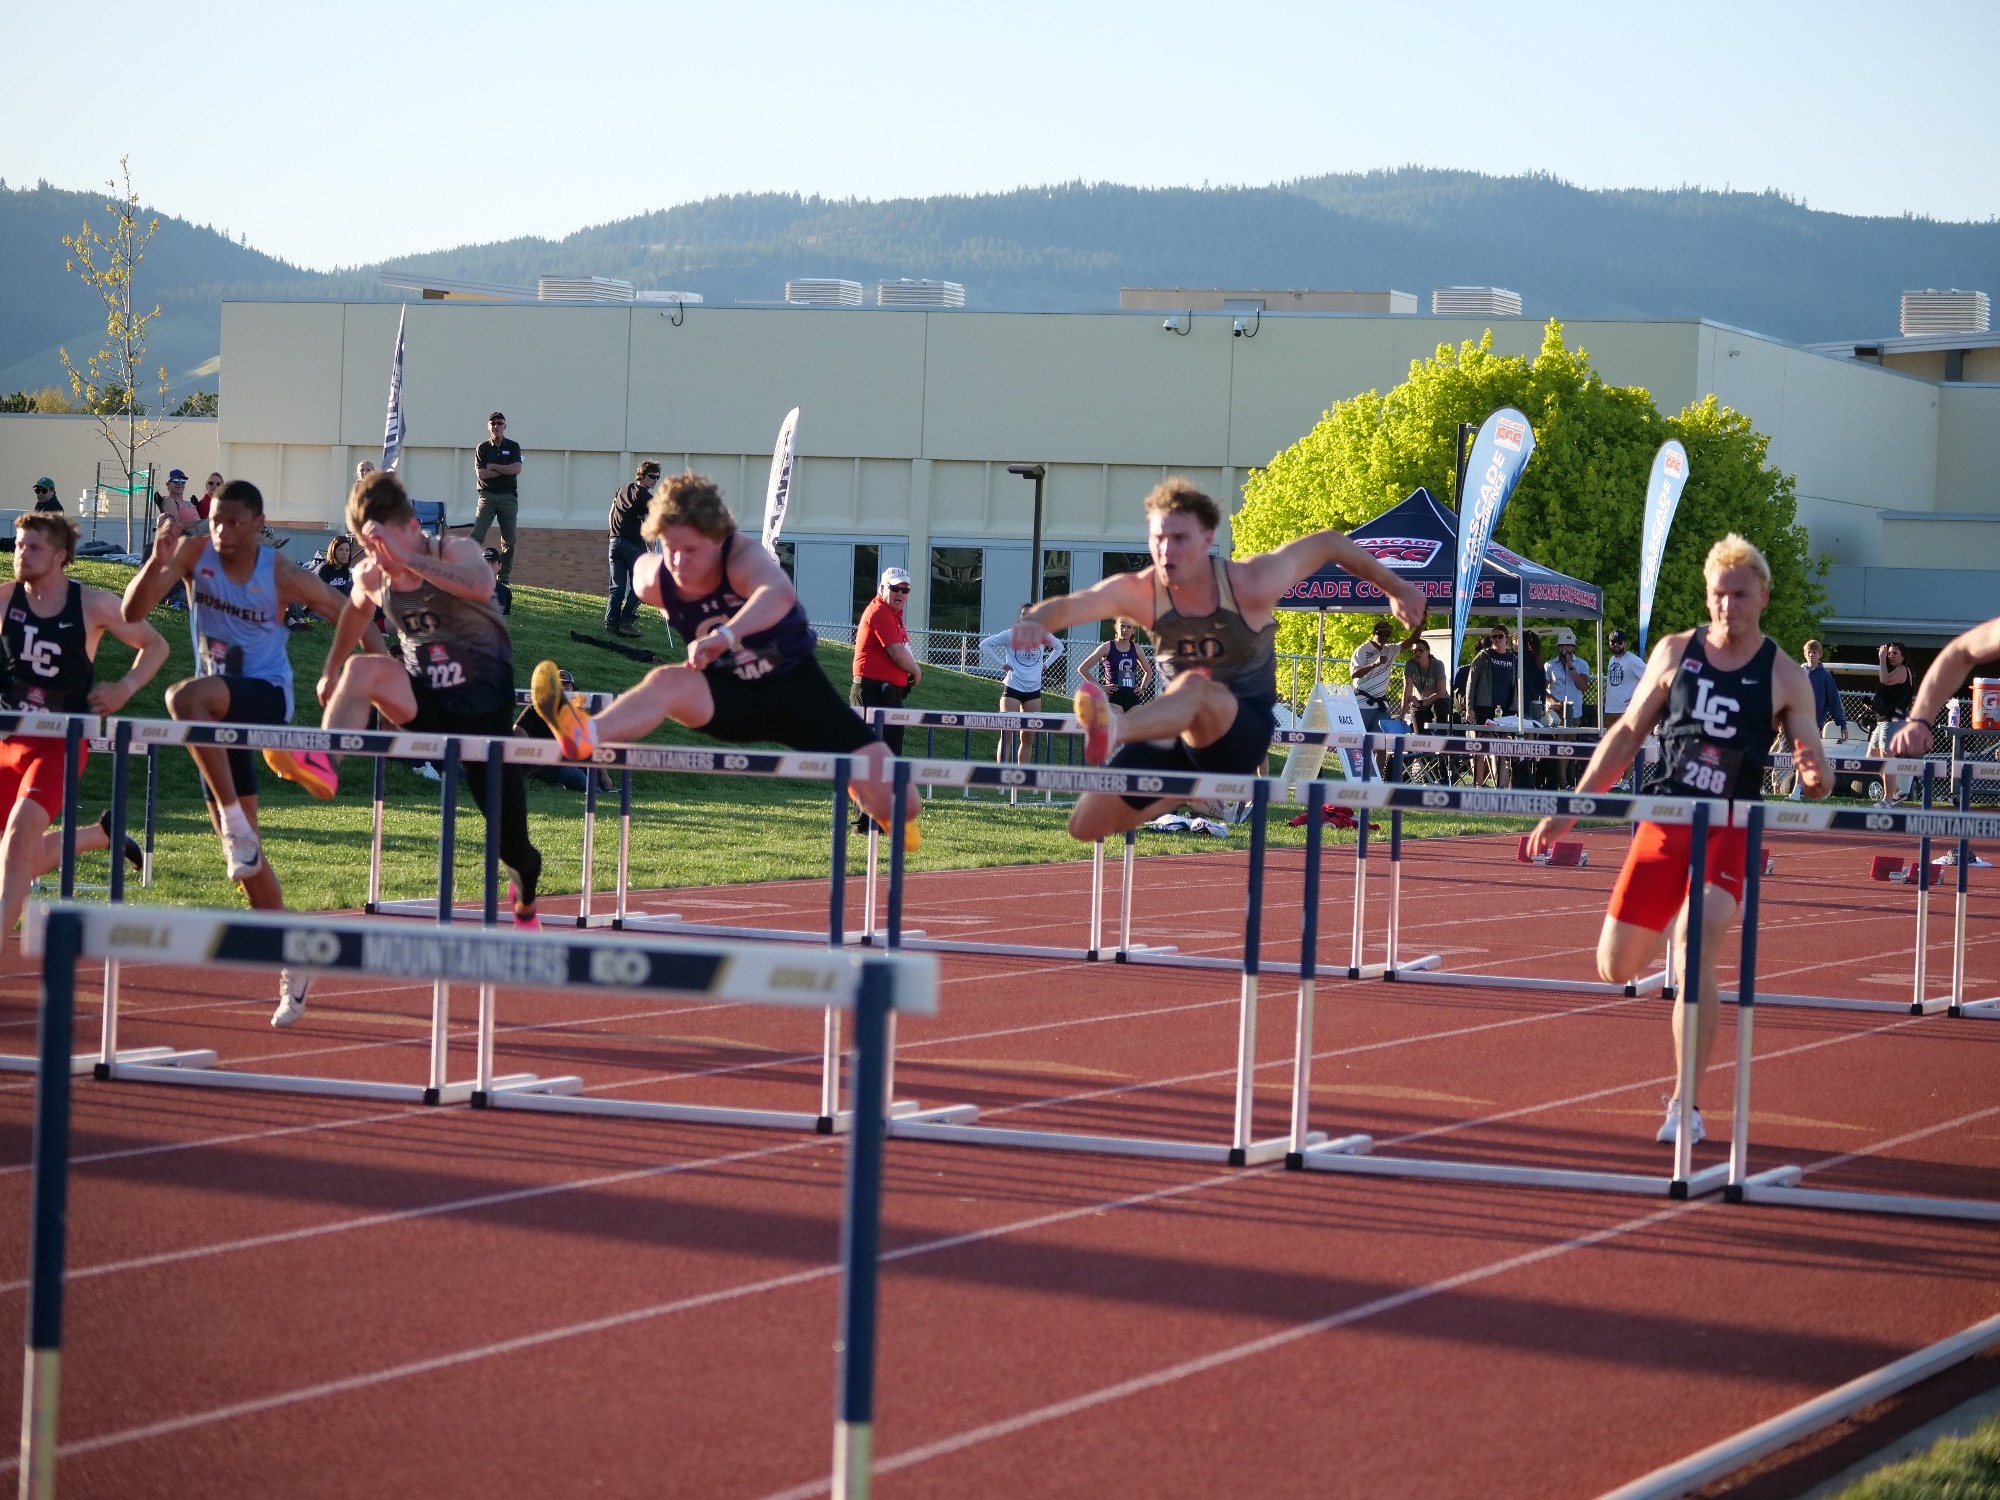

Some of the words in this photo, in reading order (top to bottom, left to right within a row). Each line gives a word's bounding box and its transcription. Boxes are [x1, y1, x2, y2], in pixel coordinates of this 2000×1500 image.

[1461, 450, 1506, 574] CASCADE
[1356, 539, 1440, 547] CASCADE
[1283, 581, 1351, 598] SCADE
[1529, 583, 1559, 600] CASCADE
[195, 592, 266, 622] BUSHNELL
[20, 624, 62, 677] LC
[427, 662, 466, 688] 222
[1691, 678, 1740, 739] LC
[891, 714, 911, 722] GILL
[941, 714, 958, 725] EO
[964, 715, 1021, 729] MOUNTAINEERS
[1027, 718, 1044, 728] EO
[214, 728, 238, 743] EO
[246, 729, 331, 750] MOUNTAINEERS
[339, 735, 364, 750] EO
[1288, 733, 1306, 743] EO
[1412, 740, 1432, 748] GILL
[1465, 741, 1482, 751] EO
[1489, 741, 1551, 756] MOUNTAINEERS
[1557, 746, 1575, 756] EO
[625, 749, 714, 770] MOUNTAINEERS
[723, 754, 749, 770] EO
[1843, 759, 1862, 770] EO
[1897, 764, 1918, 772] GILL
[1001, 769, 1027, 785] EO
[1035, 770, 1128, 792] MOUNTAINEERS
[1137, 777, 1163, 792] EO
[1215, 783, 1246, 795] GILL
[1682, 761, 1726, 795] 288
[1338, 789, 1369, 800] GILL
[1421, 791, 1450, 807] EO
[1459, 791, 1558, 814] MOUNTAINEERS
[1568, 798, 1597, 815] EO
[1776, 812, 1809, 824] GILL
[1865, 813, 1894, 830] EO
[363, 932, 569, 983] MOUNTAINEERS
